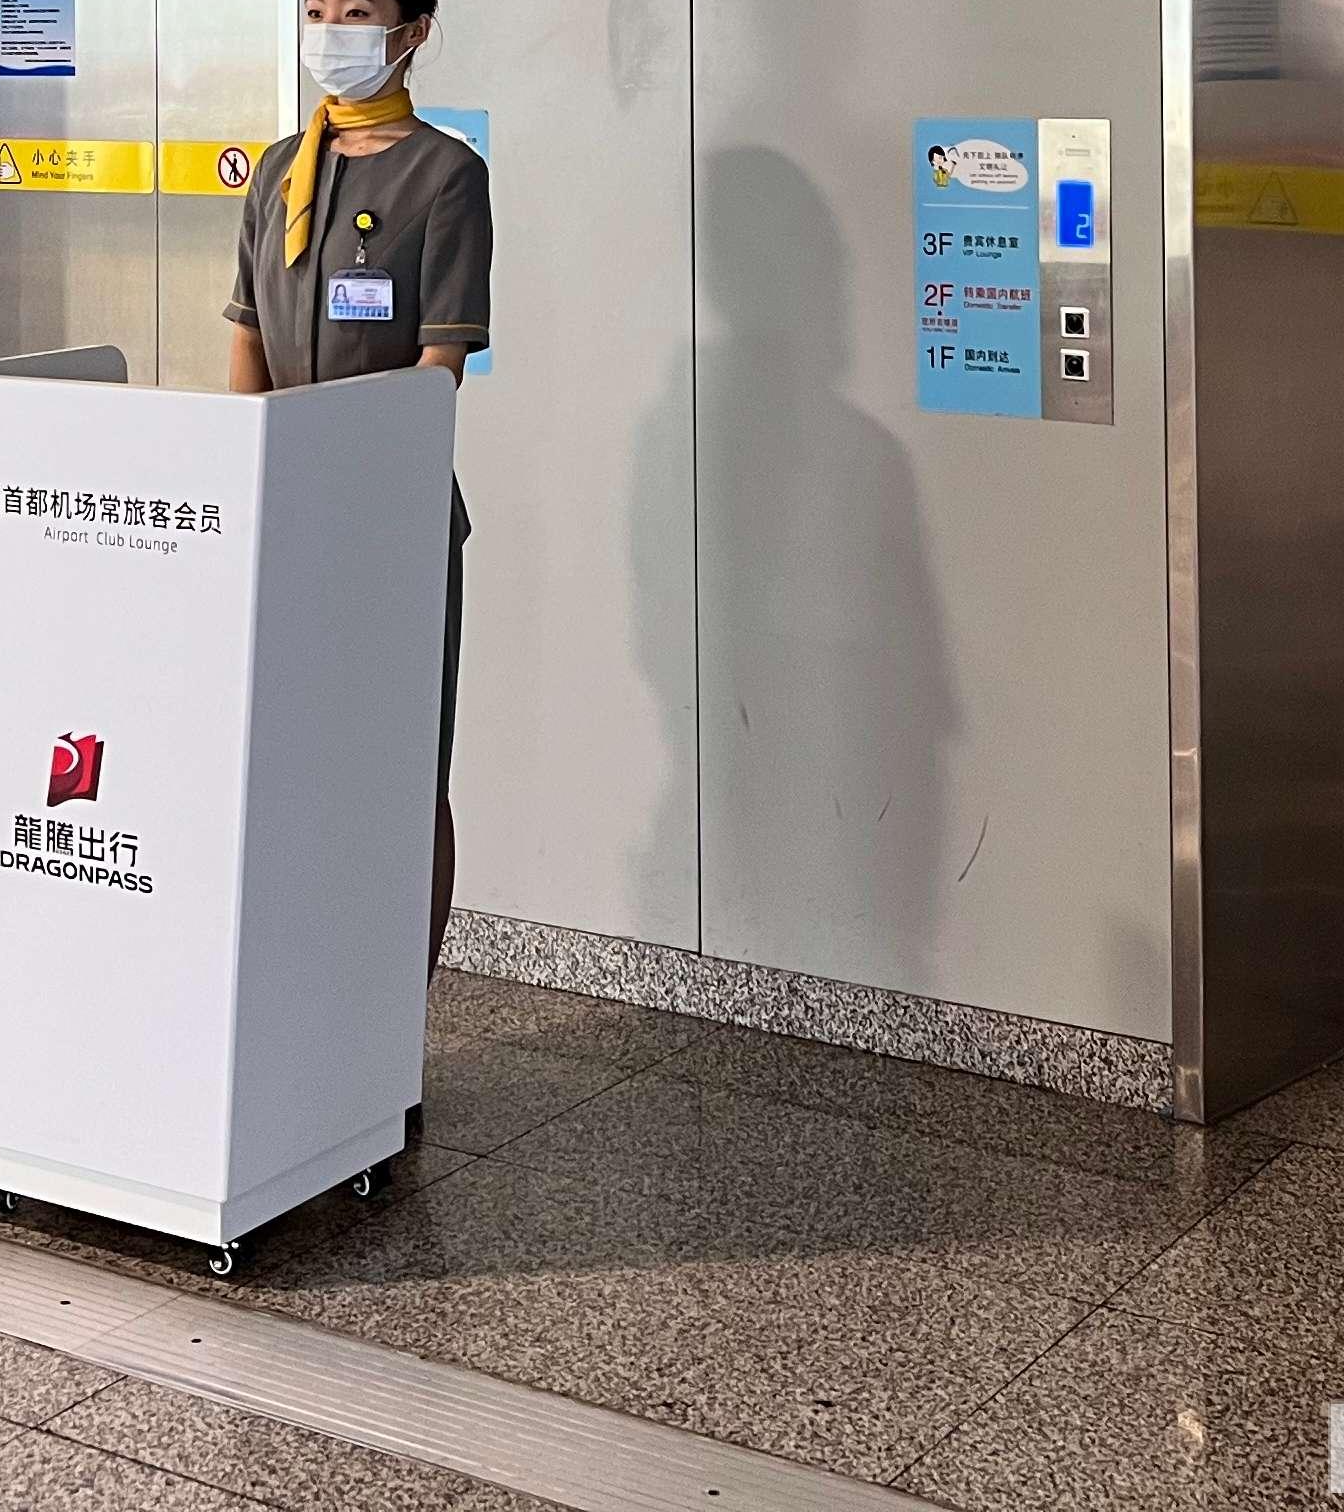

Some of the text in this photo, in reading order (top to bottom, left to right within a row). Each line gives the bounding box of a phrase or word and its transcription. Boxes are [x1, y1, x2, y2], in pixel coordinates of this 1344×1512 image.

[31, 148, 96, 168] 小心夹手
[31, 170, 49, 179] Mind
[1075, 213, 1090, 239] 2
[922, 232, 954, 256] 3F
[963, 235, 1020, 249] 贵宾休息室
[923, 284, 955, 308] 2F
[926, 345, 956, 370] 1F
[964, 348, 1010, 364] 国内到达
[2, 484, 222, 535] 首都机场常旅客会员
[43, 525, 178, 555] Airport Club Lounge
[13, 813, 139, 868] 龍騰出行
[0, 849, 154, 895] DRAGONPASS
